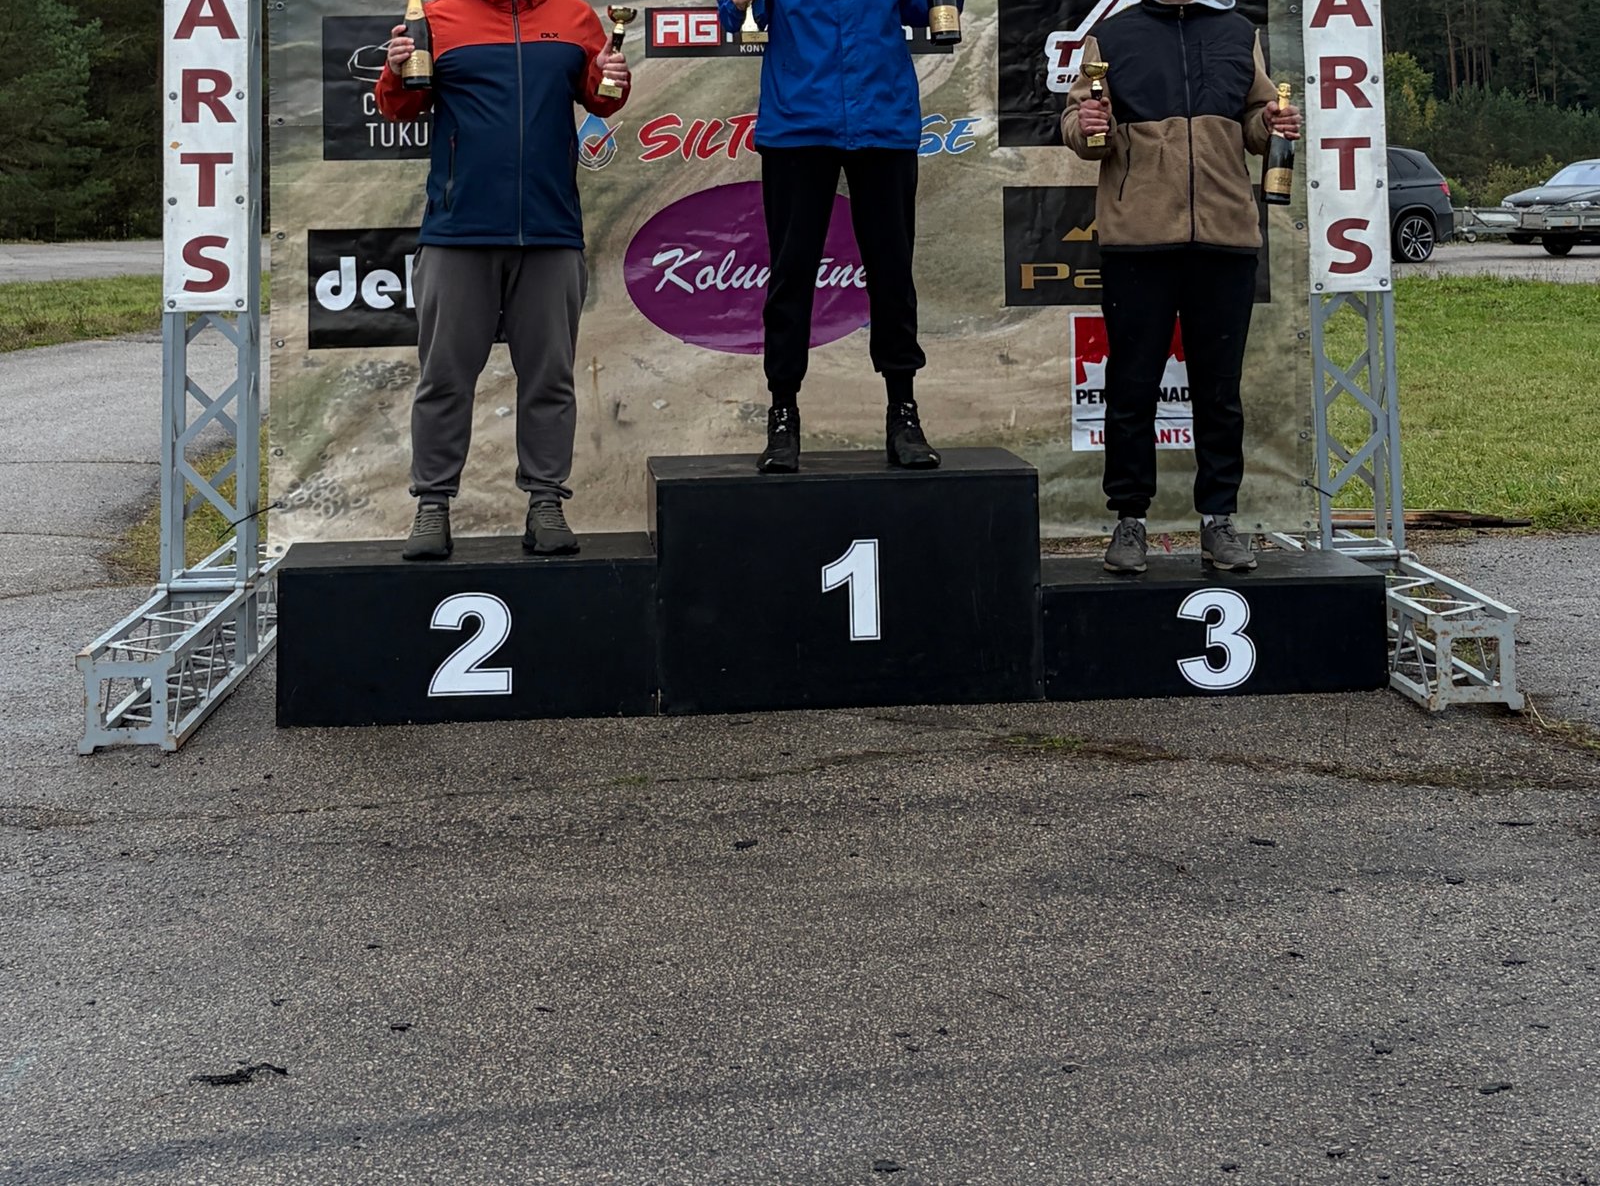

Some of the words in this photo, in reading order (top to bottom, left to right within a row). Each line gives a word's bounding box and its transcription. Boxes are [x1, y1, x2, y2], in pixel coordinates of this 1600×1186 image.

[656, 13, 718, 44] AG
[637, 112, 759, 162] SILT
[821, 539, 881, 642] 1
[1176, 588, 1257, 690] 3
[426, 592, 513, 697] 2
